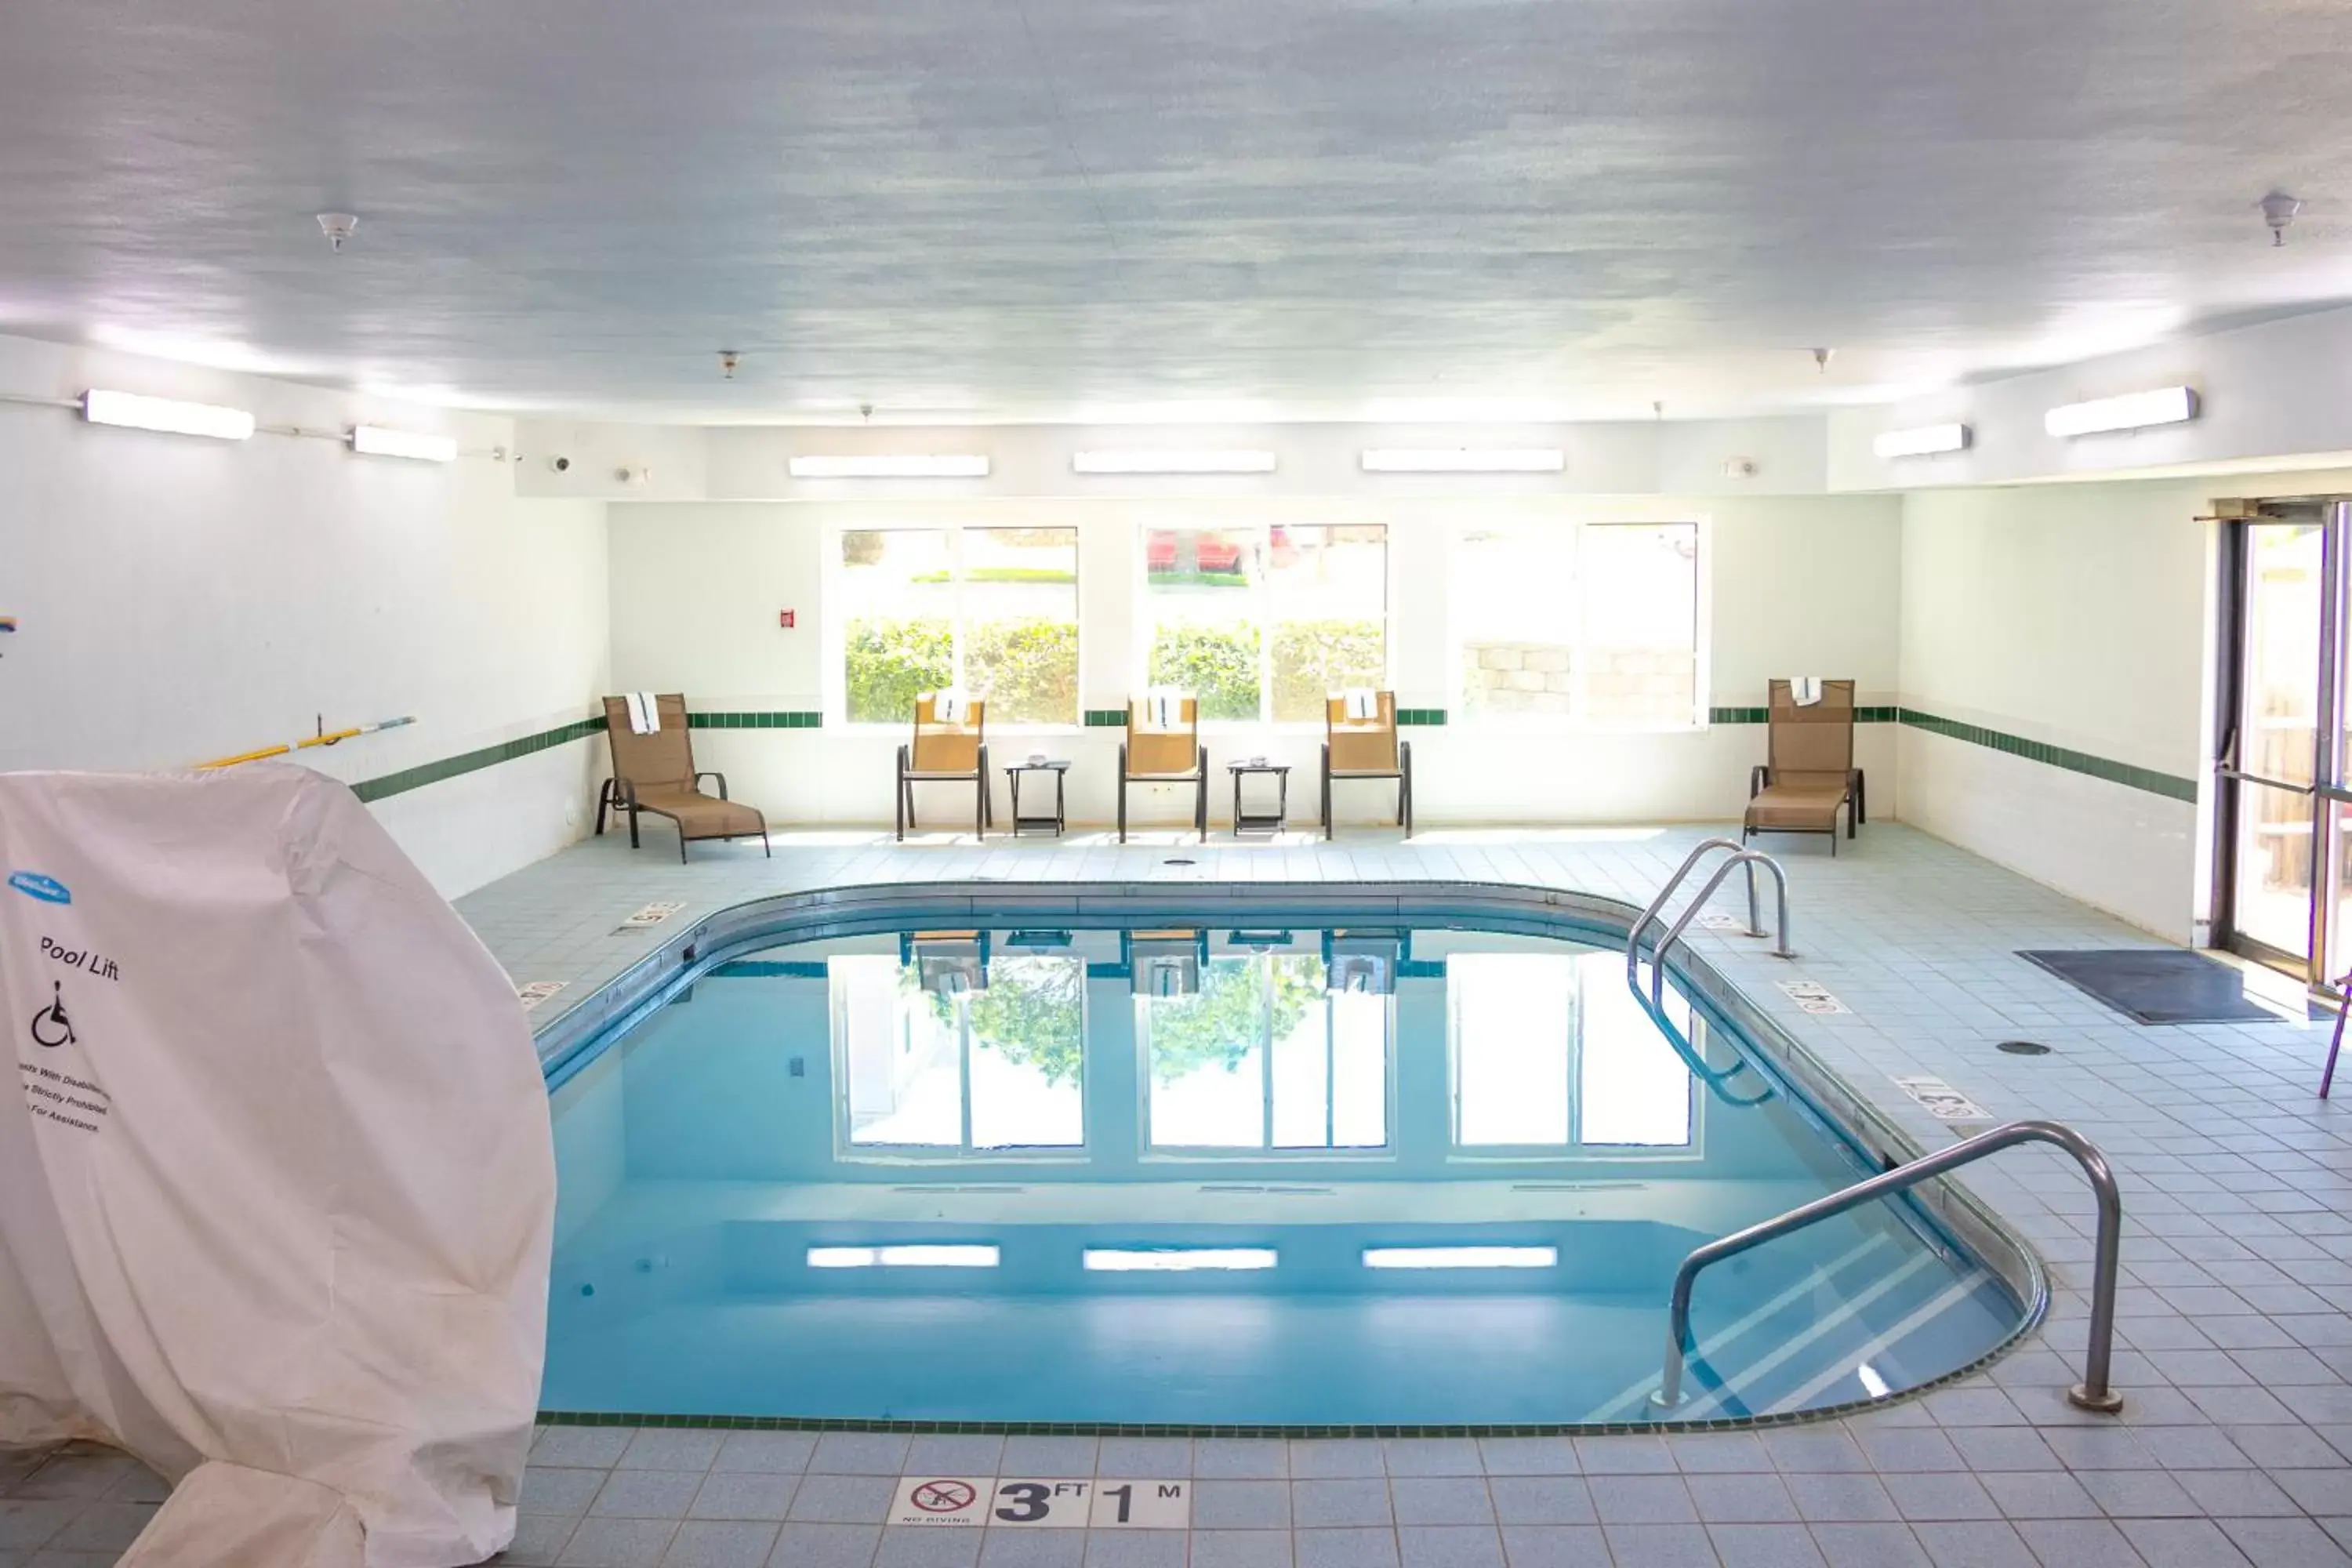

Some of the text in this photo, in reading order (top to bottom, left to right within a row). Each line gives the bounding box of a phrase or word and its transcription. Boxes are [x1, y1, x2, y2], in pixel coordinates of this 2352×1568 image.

[40, 935, 120, 982] Pool Lift
[40, 1067, 62, 1083] With
[31, 1084, 65, 1103] Strictly
[31, 1105, 48, 1116] For
[995, 1482, 1181, 1523] 3 FT 1 M
